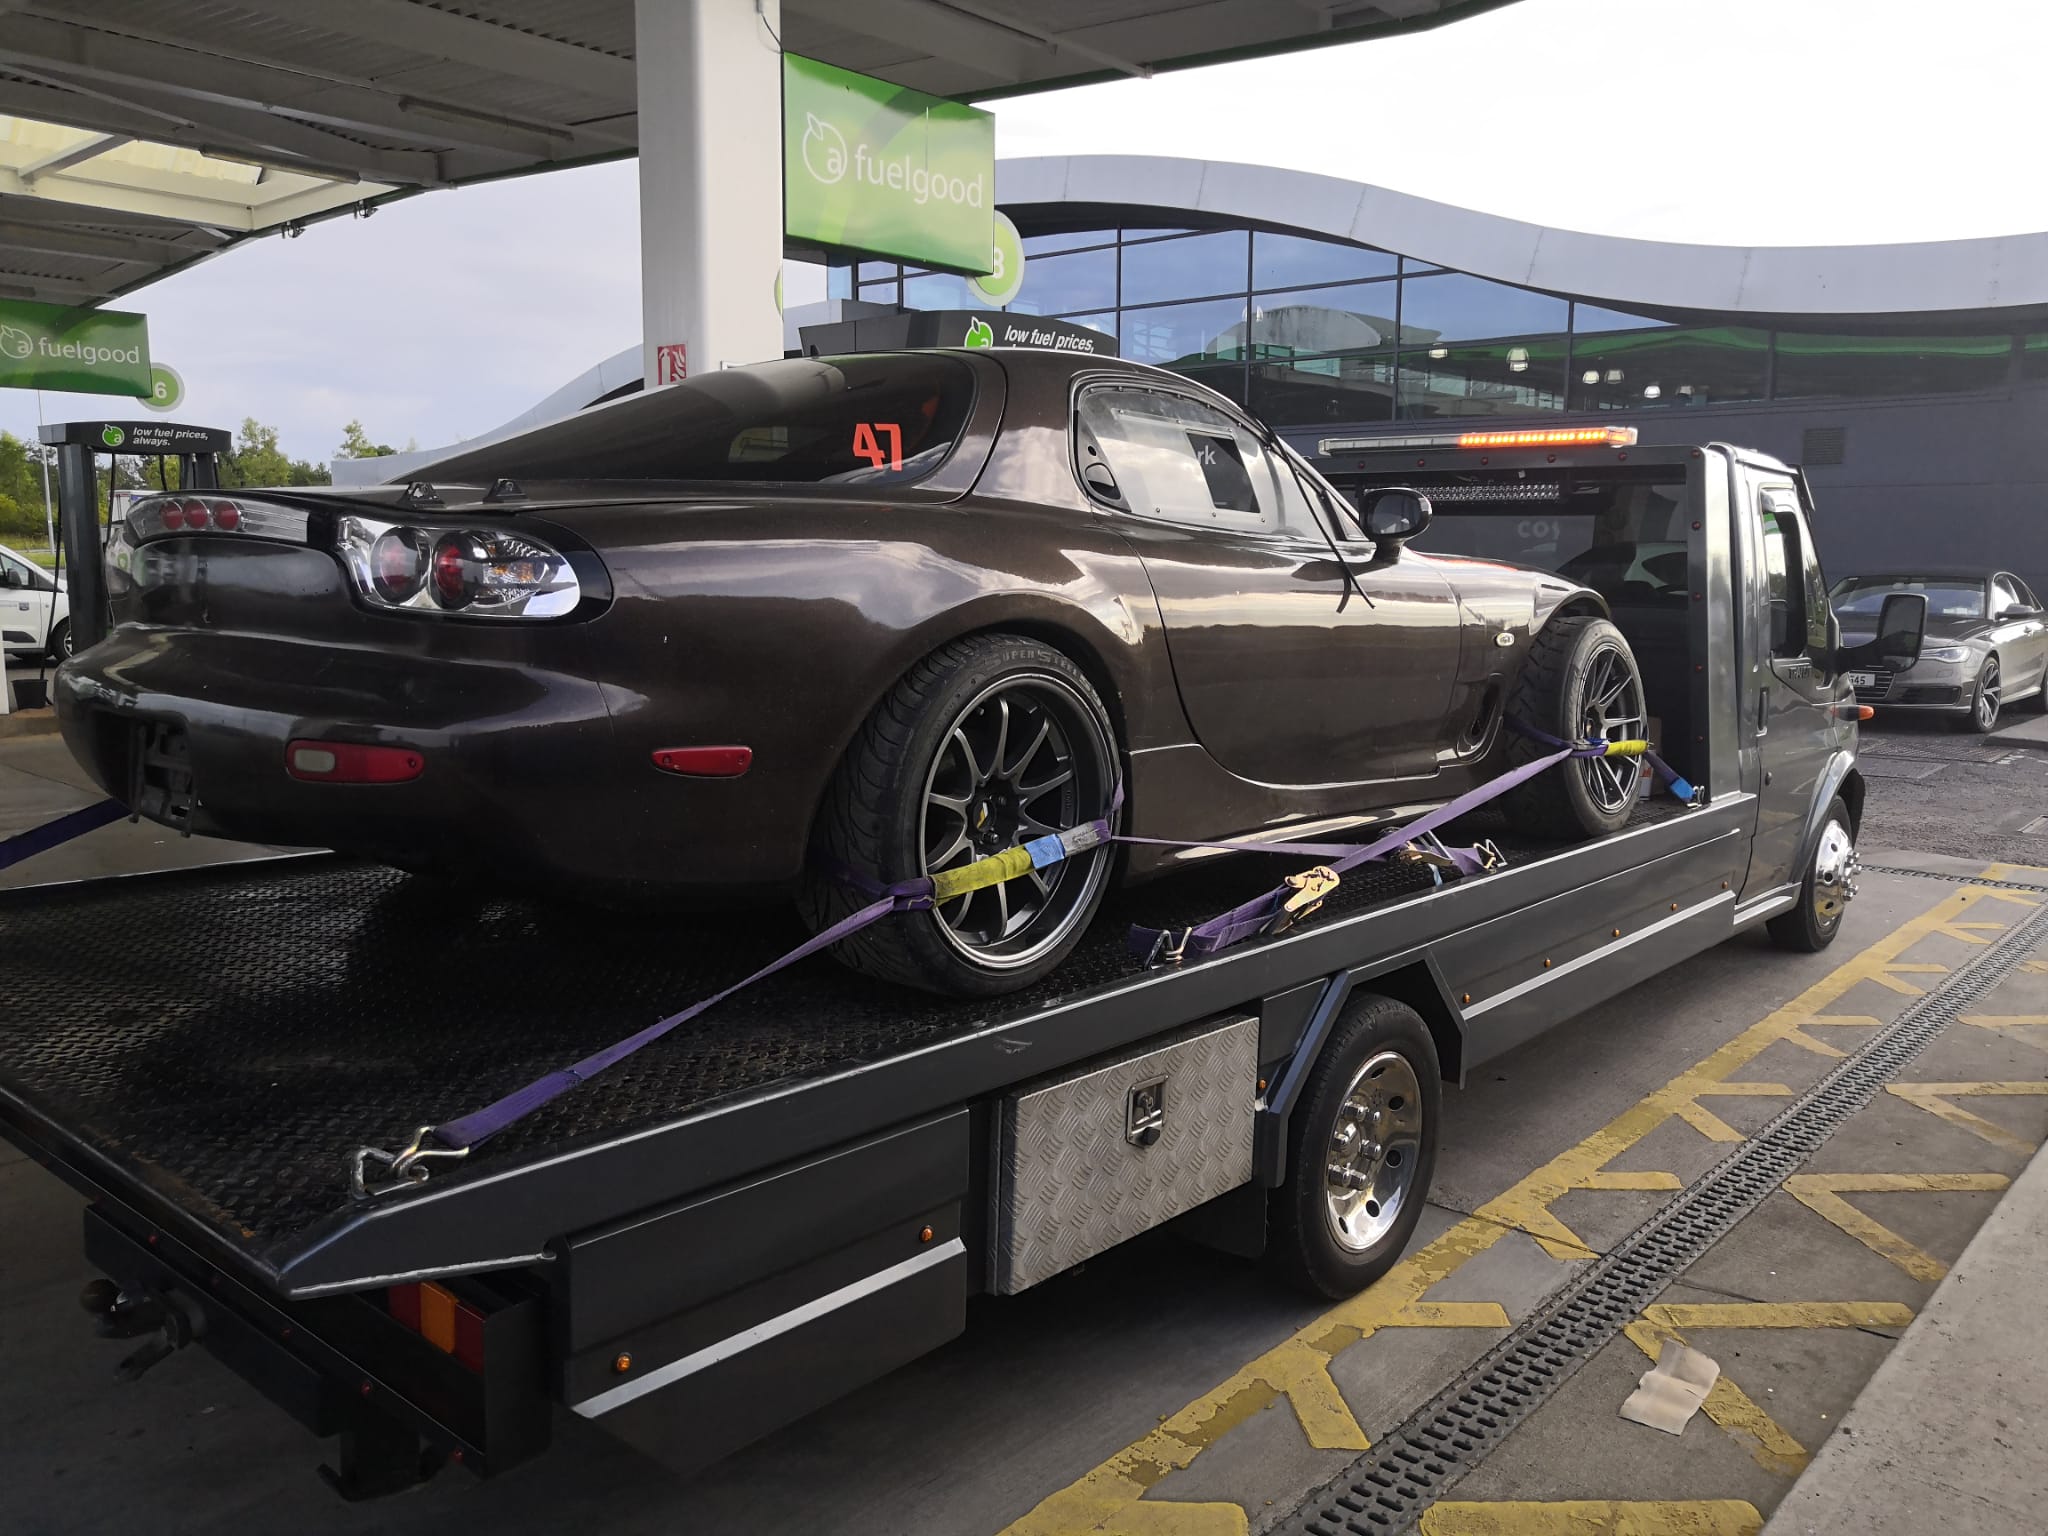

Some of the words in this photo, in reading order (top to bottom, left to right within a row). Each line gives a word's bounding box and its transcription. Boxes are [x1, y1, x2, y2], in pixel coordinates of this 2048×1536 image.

[854, 143, 983, 209] fuelgood
[38, 336, 140, 366] fuelgood
[1004, 325, 1029, 343] low
[1029, 328, 1056, 347] fuel
[1055, 333, 1095, 353] prices,
[154, 381, 168, 399] 6
[132, 427, 153, 437] low
[154, 428, 174, 438] fuel
[175, 430, 209, 441] prices,
[132, 436, 171, 447] always.
[852, 423, 903, 472] 47
